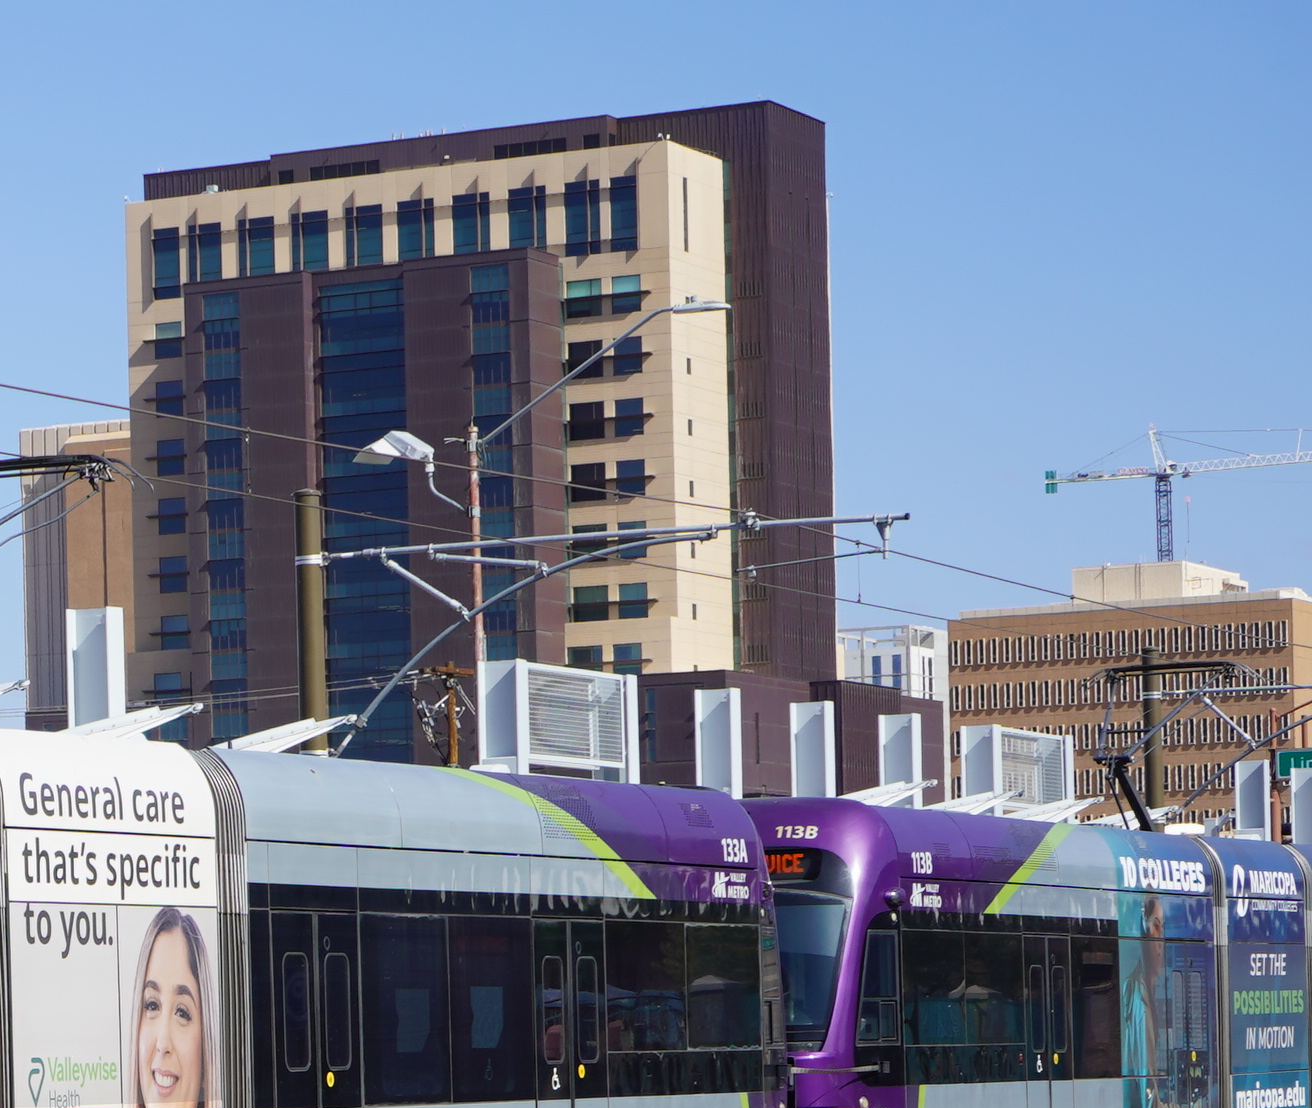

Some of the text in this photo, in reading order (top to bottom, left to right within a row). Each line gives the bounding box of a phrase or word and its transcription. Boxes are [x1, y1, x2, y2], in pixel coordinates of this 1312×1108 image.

[19, 772, 185, 824] General care
[775, 825, 819, 839] 113B
[721, 838, 749, 863] 133A
[765, 853, 804, 873] VICE
[911, 851, 933, 874] 113B
[22, 836, 201, 900] that's specific
[1119, 856, 1206, 893] 10 COLLEGES
[727, 885, 749, 899] METRO
[1248, 869, 1298, 896] MARICOPA
[923, 894, 942, 908] METRO
[23, 901, 114, 960] to you.
[1250, 953, 1287, 976] SET THE
[1233, 989, 1304, 1015] POSSIBILITIES
[1246, 1025, 1295, 1050] IN MOTION
[47, 1056, 118, 1088] Valleywise
[48, 1089, 81, 1108] Health
